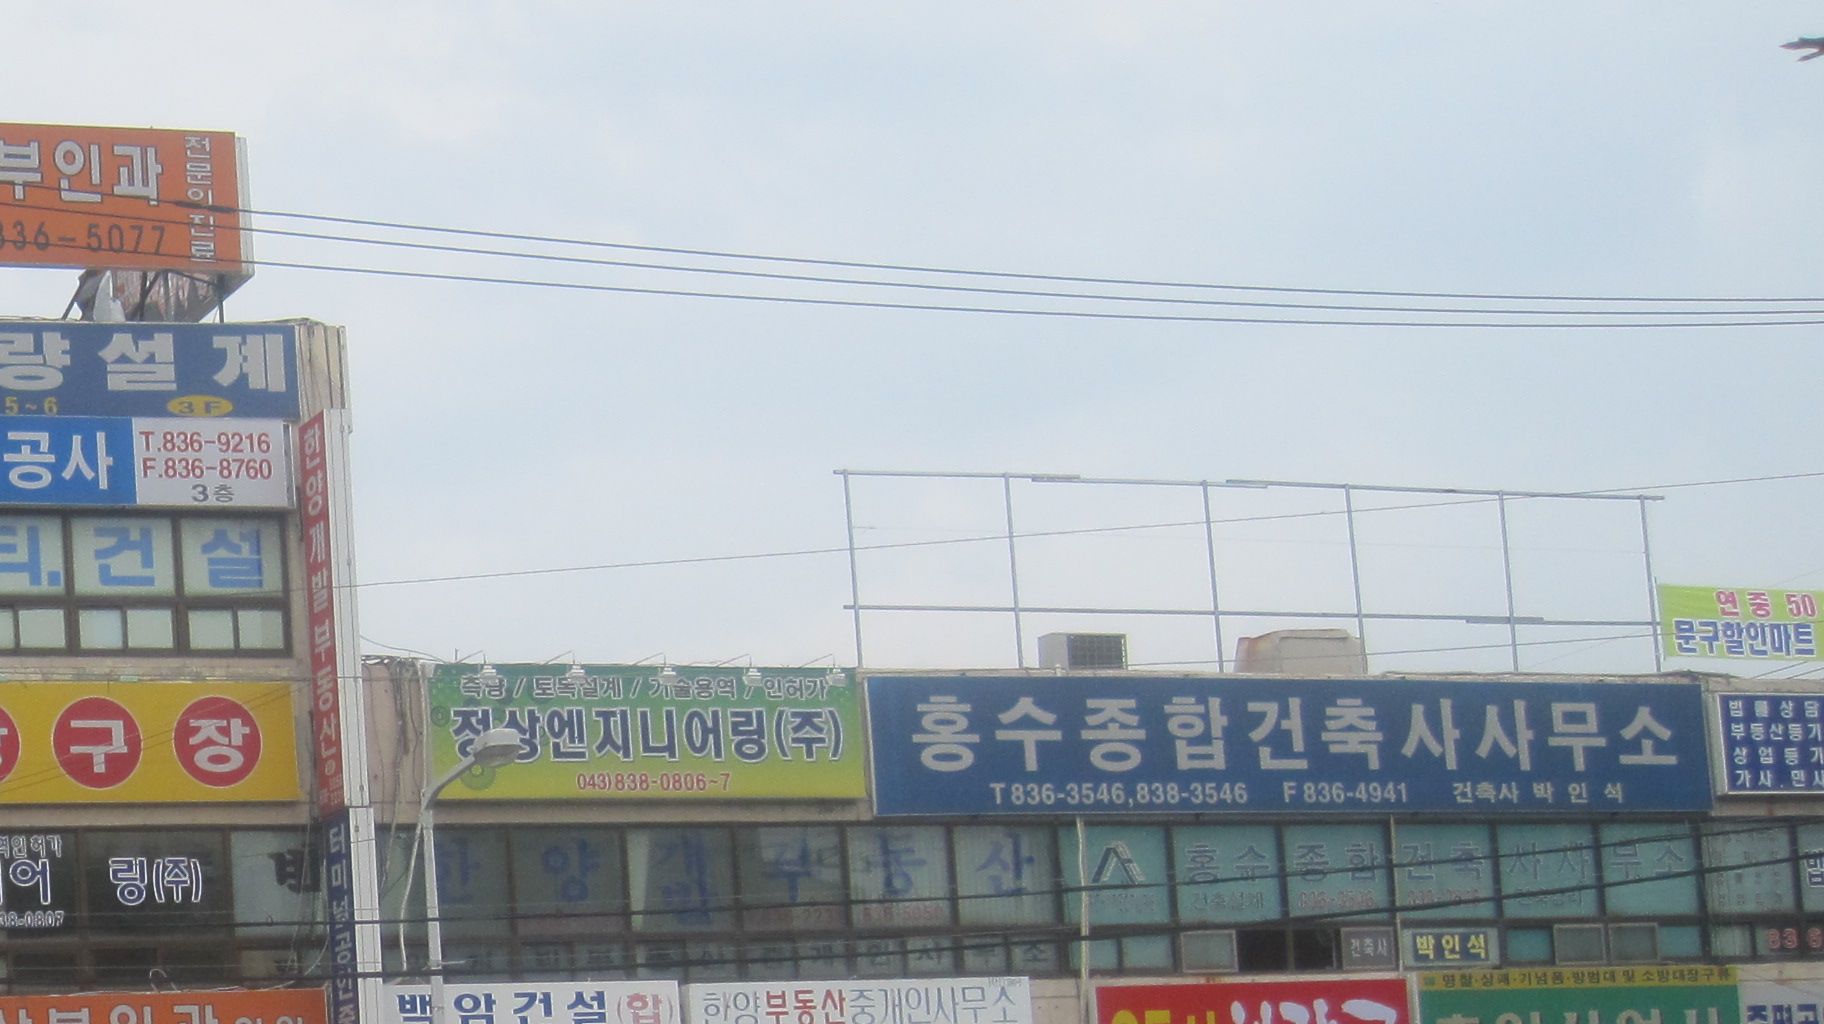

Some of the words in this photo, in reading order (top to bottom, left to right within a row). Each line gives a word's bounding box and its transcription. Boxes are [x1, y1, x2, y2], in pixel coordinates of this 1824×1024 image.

[140, 429, 273, 456] T.836-9216
[140, 456, 274, 481] F.836-8760
[190, 483, 237, 505] 3층
[1673, 618, 1817, 657] 문구할인마트
[911, 694, 1678, 772] 홍수종합건축사사무소
